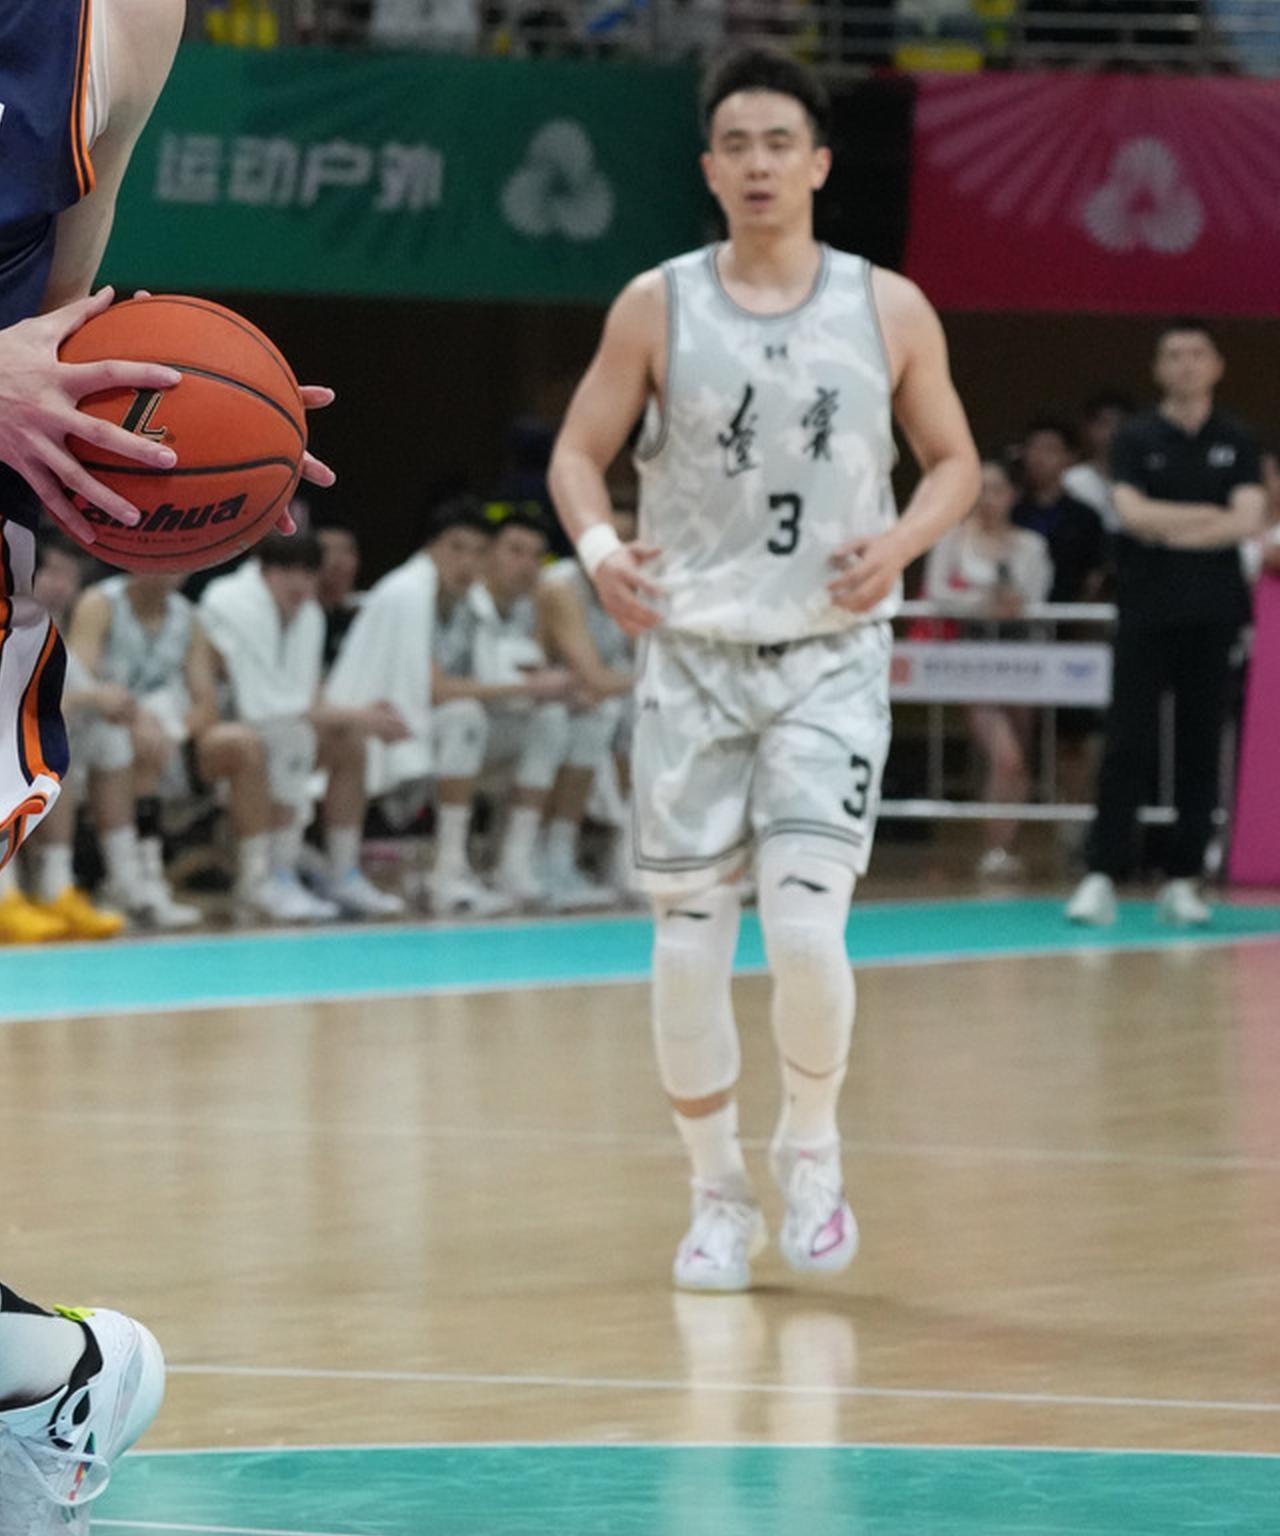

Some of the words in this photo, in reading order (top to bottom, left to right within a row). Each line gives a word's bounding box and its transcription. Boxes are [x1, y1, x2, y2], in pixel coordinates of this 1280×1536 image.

[154, 133, 442, 212] 运动户外
[767, 492, 803, 555] 3
[842, 753, 873, 819] 3
